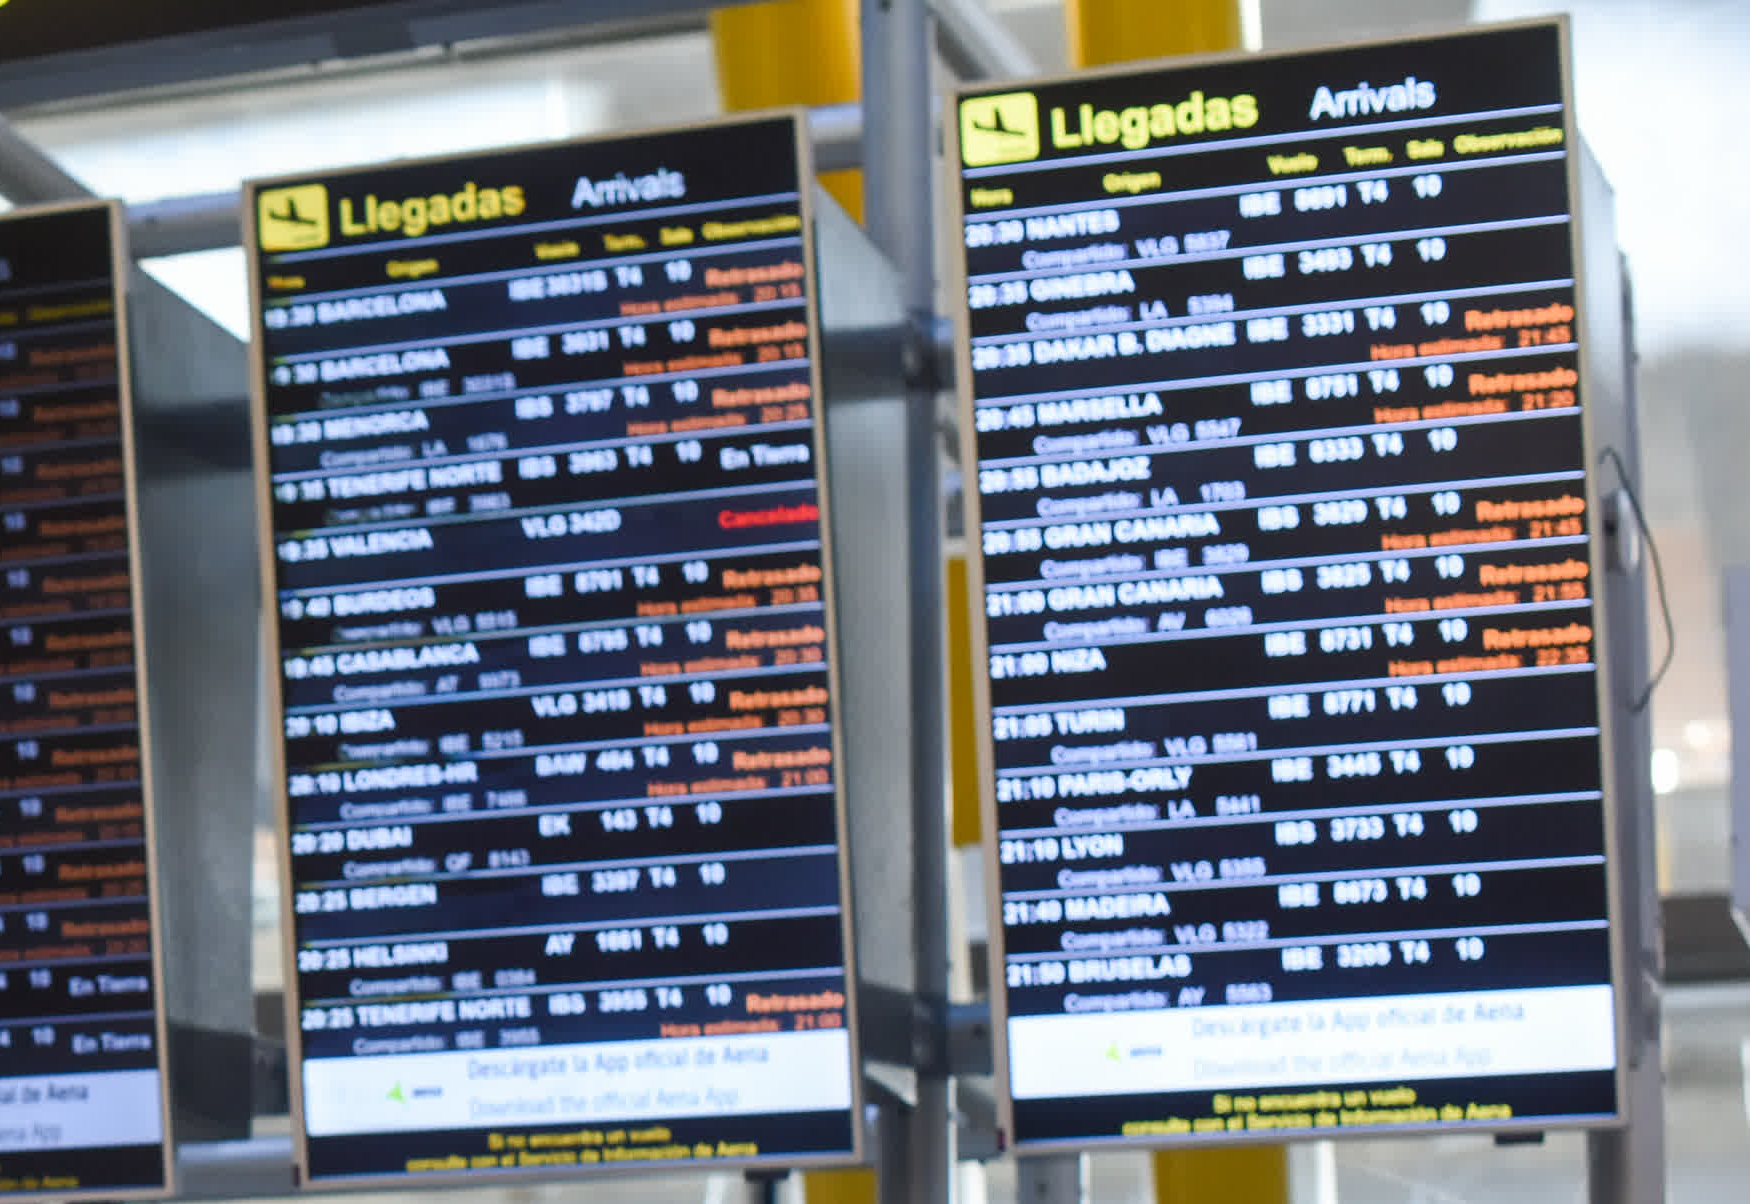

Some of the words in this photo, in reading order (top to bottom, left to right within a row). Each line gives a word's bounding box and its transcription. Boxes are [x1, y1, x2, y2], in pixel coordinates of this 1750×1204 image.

[1052, 90, 1258, 151] Llegadas
[1310, 76, 1436, 121] Arrivals
[340, 182, 524, 237] Llegadas
[572, 167, 685, 208] Arrivals
[1356, 177, 1389, 204] T4
[1412, 173, 1443, 198] 10
[1360, 241, 1393, 267] T4
[1416, 236, 1447, 262] 10
[720, 446, 746, 470] En
[750, 441, 810, 466] Tierra
[1372, 432, 1404, 457] T4
[1427, 428, 1458, 452] 10
[1385, 686, 1418, 710] T4
[1442, 683, 1472, 706] 10
[1389, 749, 1421, 773] T4
[1445, 746, 1475, 769] 10
[1392, 813, 1425, 837] T4
[1448, 810, 1478, 832] 10
[1399, 939, 1431, 963] T4
[1455, 936, 1485, 961] 10
